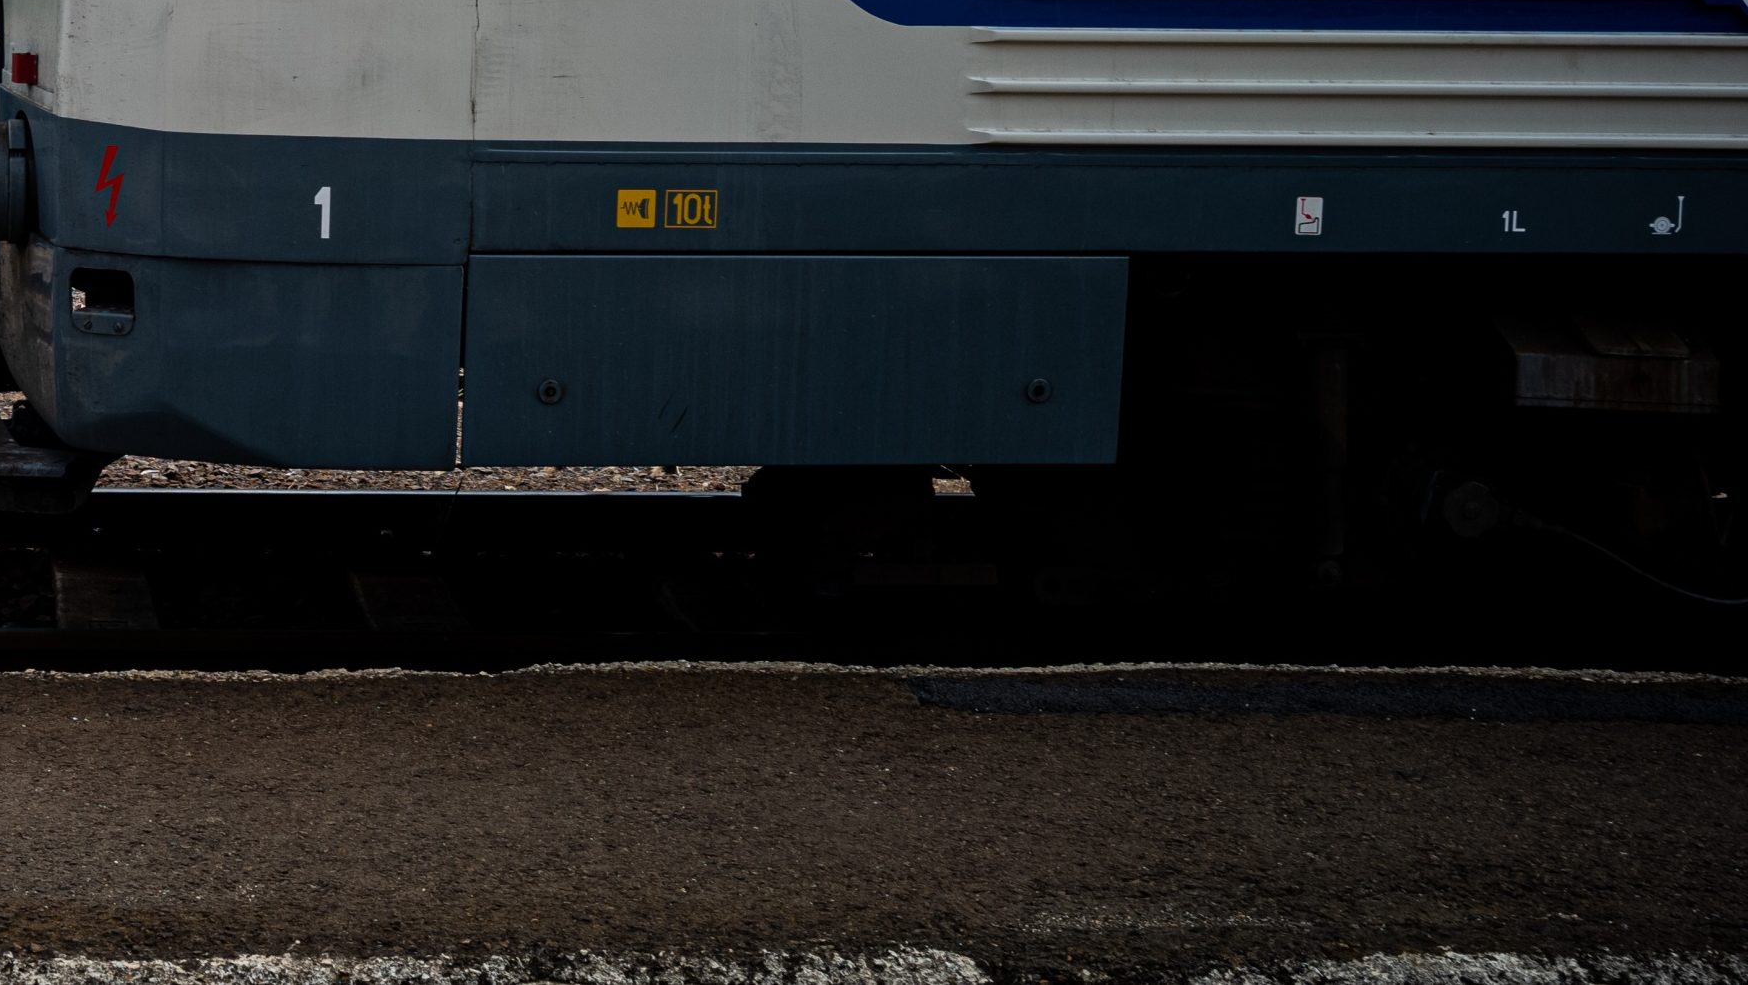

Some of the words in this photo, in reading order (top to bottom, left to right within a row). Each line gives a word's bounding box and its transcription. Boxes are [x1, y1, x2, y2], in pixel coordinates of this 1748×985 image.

[314, 186, 331, 239] 1
[672, 191, 716, 227] 10t
[1501, 209, 1526, 233] 1L
